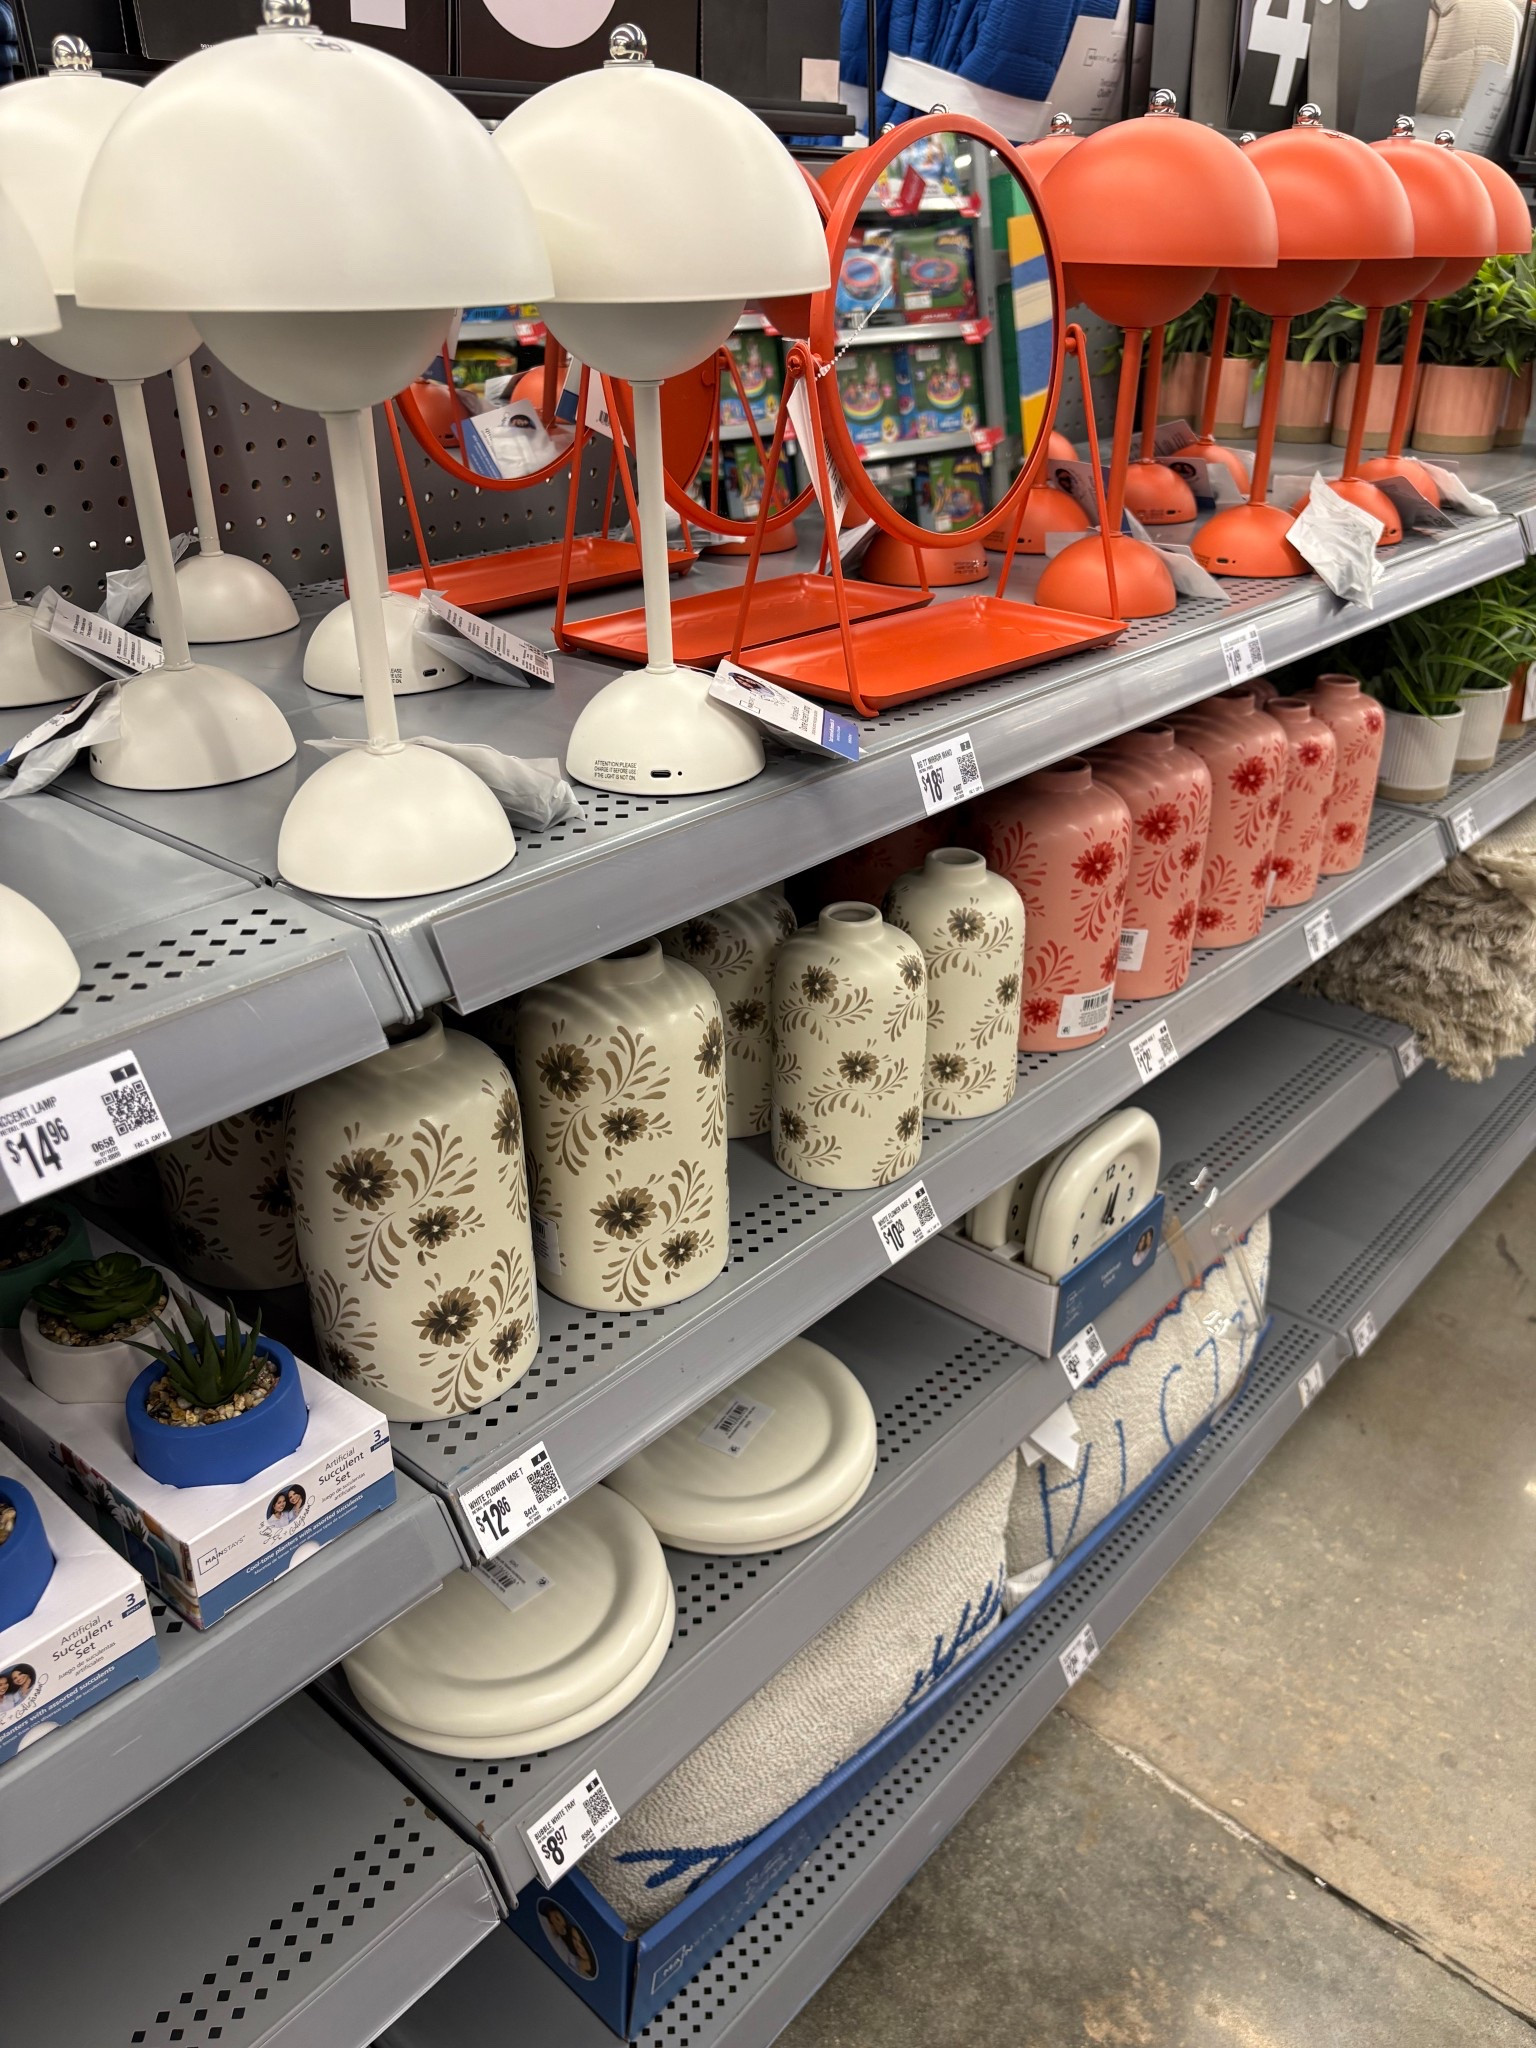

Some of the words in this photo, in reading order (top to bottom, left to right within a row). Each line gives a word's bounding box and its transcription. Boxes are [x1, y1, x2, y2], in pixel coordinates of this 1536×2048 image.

[31, 1096, 57, 1114] LAMP
[91, 1136, 115, 1153] 0658
[1106, 1163, 1116, 1182] 12
[1127, 1187, 1134, 1201] 3
[1011, 1204, 1019, 1219] 9
[1071, 1233, 1079, 1249] 9
[373, 1429, 382, 1443] 3
[318, 1452, 364, 1485] Succulent
[325, 1447, 355, 1471] Artificial
[335, 1471, 351, 1485] Set
[468, 1494, 486, 1510] WHITE
[485, 1480, 507, 1498] FLOWER
[506, 1470, 520, 1484] VASE
[246, 1553, 274, 1573] Cool-tone
[275, 1537, 298, 1555] planters
[299, 1528, 312, 1538] with
[313, 1511, 335, 1530] assorted
[336, 1495, 363, 1514] succulents
[126, 1593, 136, 1608] 3
[52, 1620, 113, 1661] Succulent
[61, 1616, 100, 1646] Artificial
[75, 1642, 96, 1659] Set
[58, 1667, 76, 1680] Juego
[85, 1642, 116, 1662] suculentas
[75, 1656, 104, 1676] artificiales
[30, 1709, 47, 1721] with
[48, 1688, 78, 1710] assorted
[79, 1666, 115, 1690] succulents
[534, 1822, 552, 1840] BUBBLE
[551, 1809, 565, 1825] WHITE
[564, 1799, 575, 1812] TRAY
